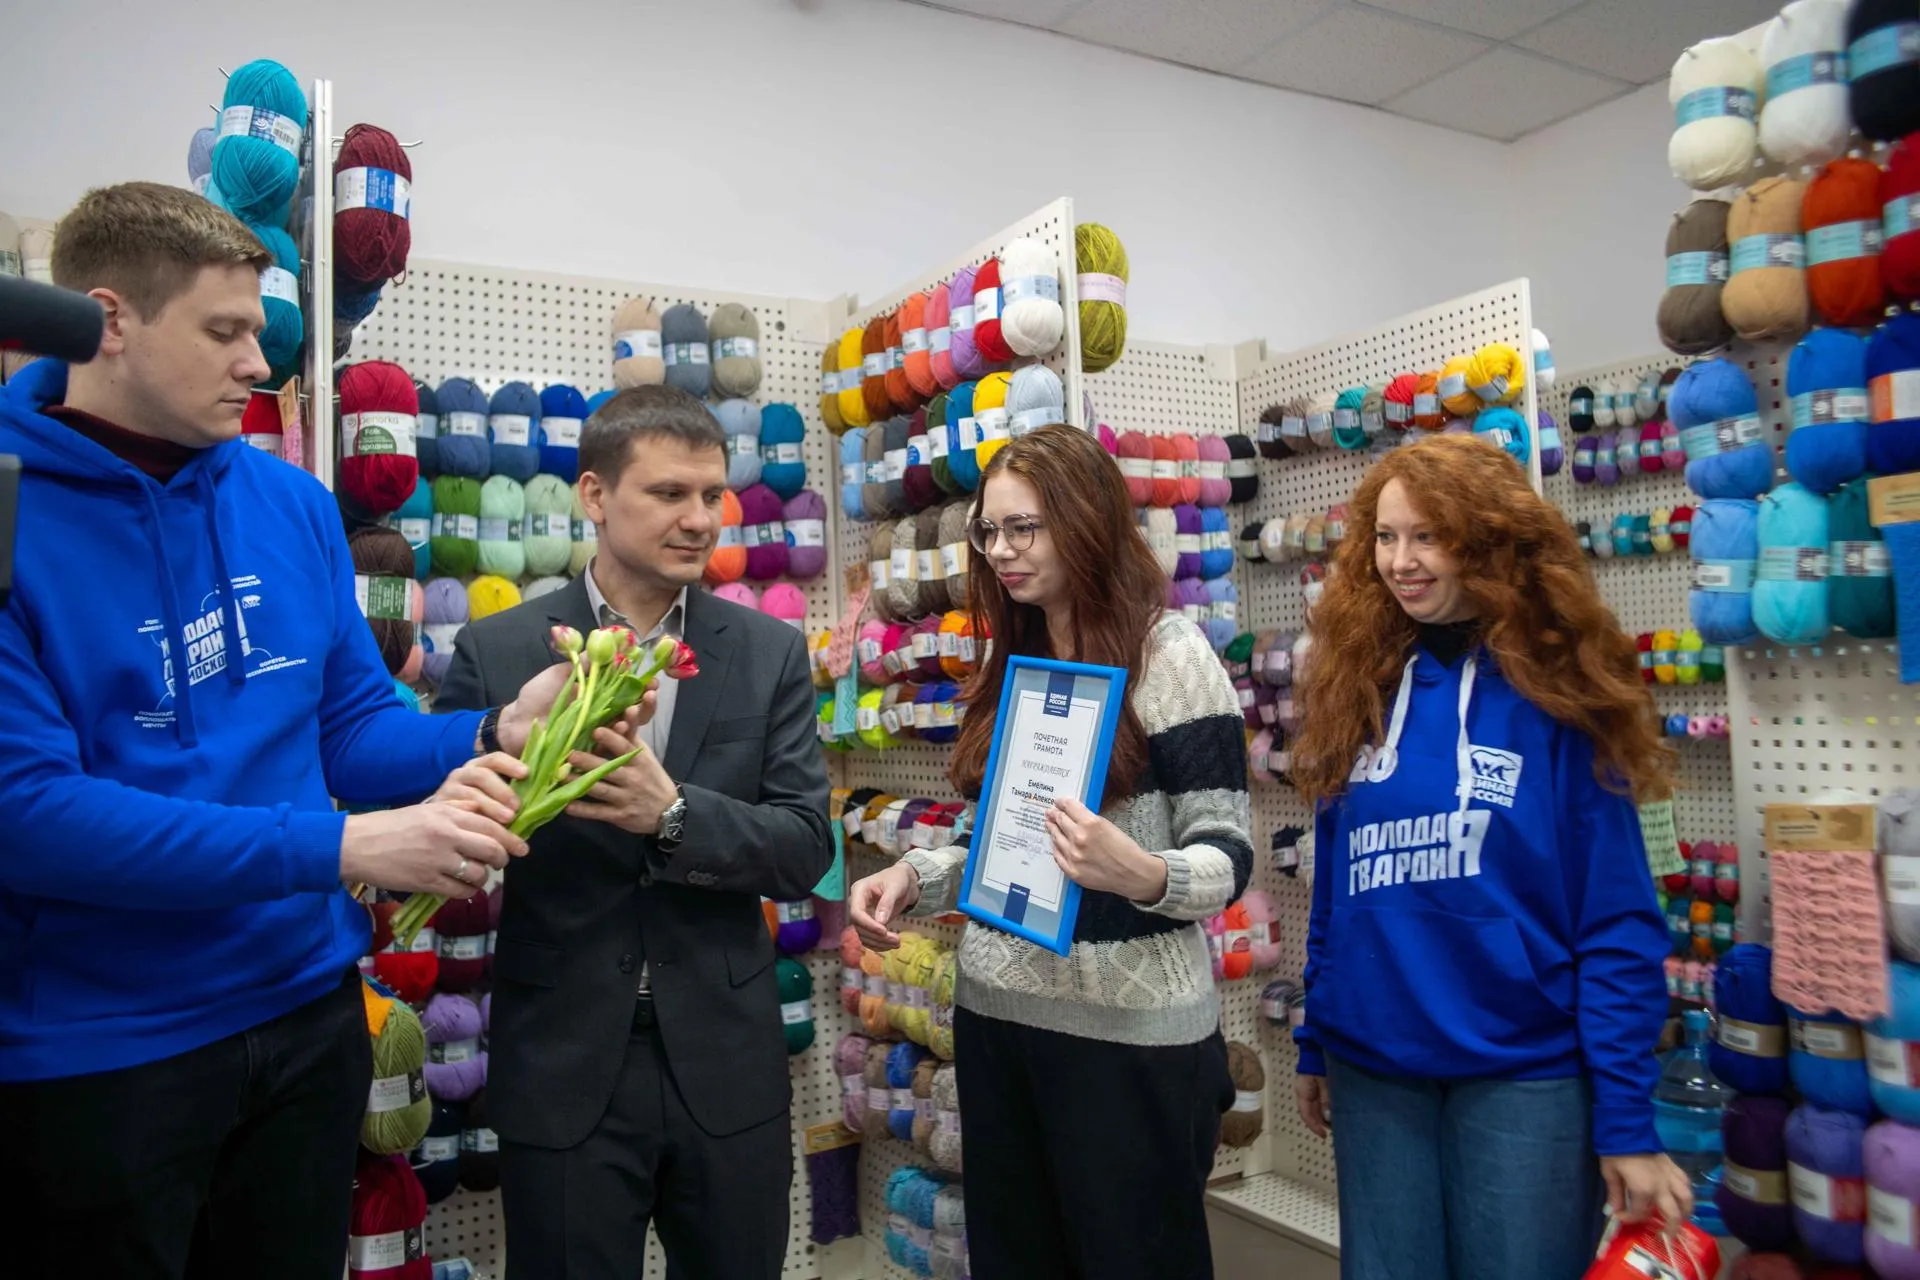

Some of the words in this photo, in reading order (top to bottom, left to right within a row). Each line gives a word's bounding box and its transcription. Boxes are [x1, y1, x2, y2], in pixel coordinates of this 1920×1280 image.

[1033, 732, 1068, 746] ПОЧЕТНАЯ
[1033, 742, 1063, 757] ГРАМОТА
[1028, 779, 1055, 793] Емелина
[1011, 786, 1032, 800] Тамара
[1032, 793, 1055, 806] Алексе
